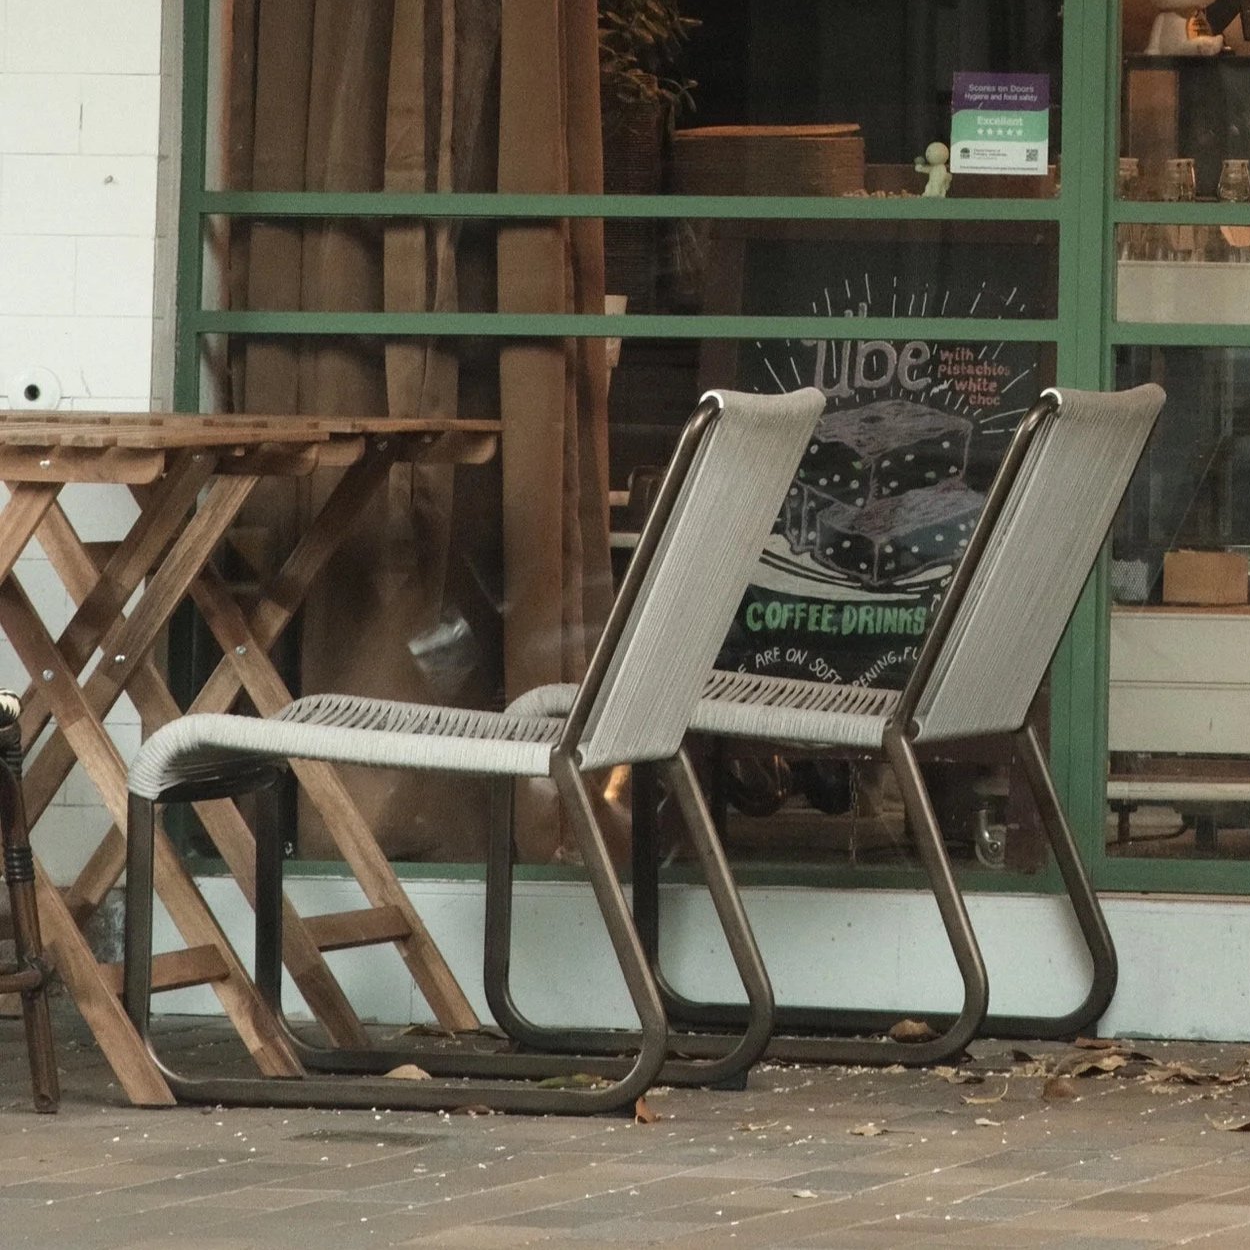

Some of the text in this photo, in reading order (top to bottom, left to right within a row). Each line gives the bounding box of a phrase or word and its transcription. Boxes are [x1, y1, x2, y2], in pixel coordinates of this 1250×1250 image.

[969, 84, 996, 93] Scores
[1011, 84, 1034, 93] Doors
[977, 116, 1023, 126] Excellent
[939, 347, 974, 362] with
[954, 379, 998, 392] white
[969, 394, 1000, 406] choc
[841, 605, 927, 635] DRINKS
[755, 647, 780, 668] ARE
[785, 648, 808, 665] ON
[809, 658, 842, 685] SOFT
[852, 651, 902, 688] PENING,
